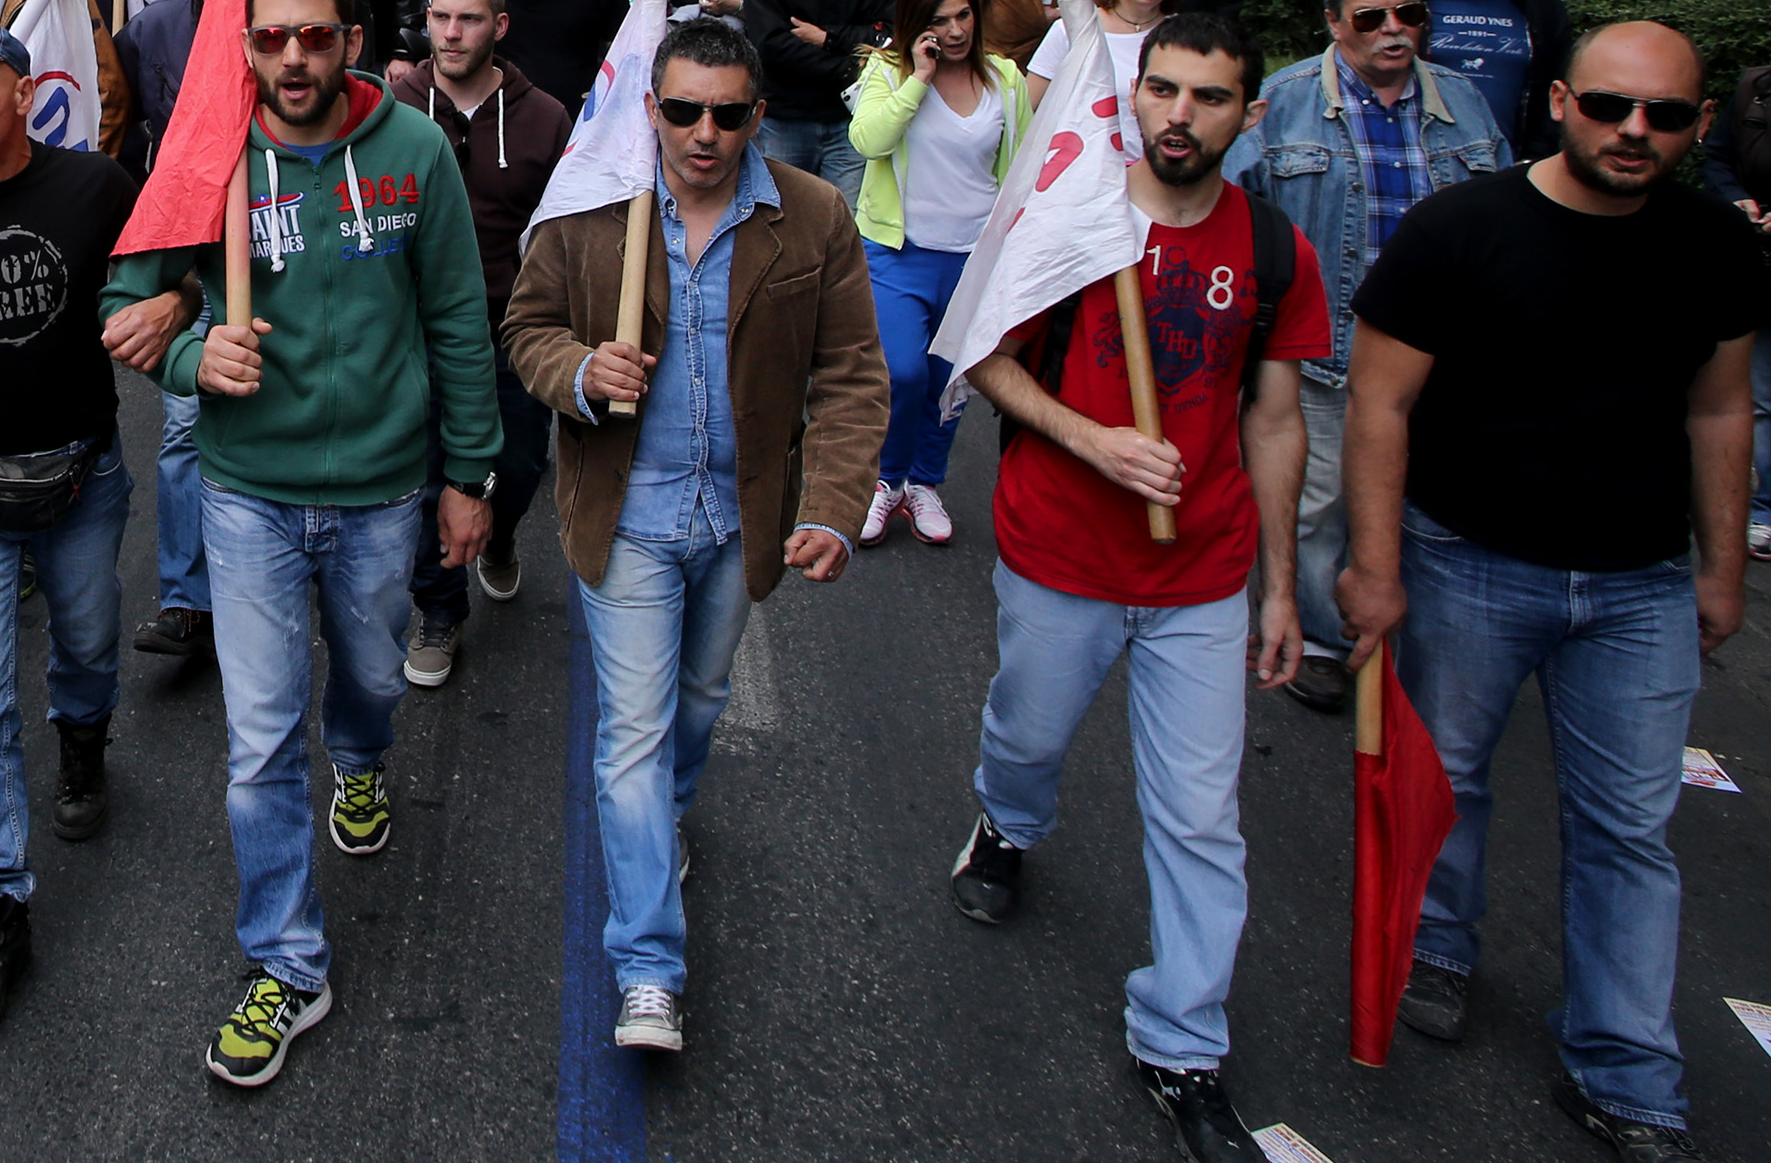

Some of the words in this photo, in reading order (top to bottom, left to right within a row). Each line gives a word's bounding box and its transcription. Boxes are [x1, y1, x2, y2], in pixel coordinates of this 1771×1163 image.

[1442, 16, 1487, 26] GERAUD
[1487, 18, 1514, 28] YNES
[333, 173, 421, 212] 1964
[340, 217, 374, 237] SAN
